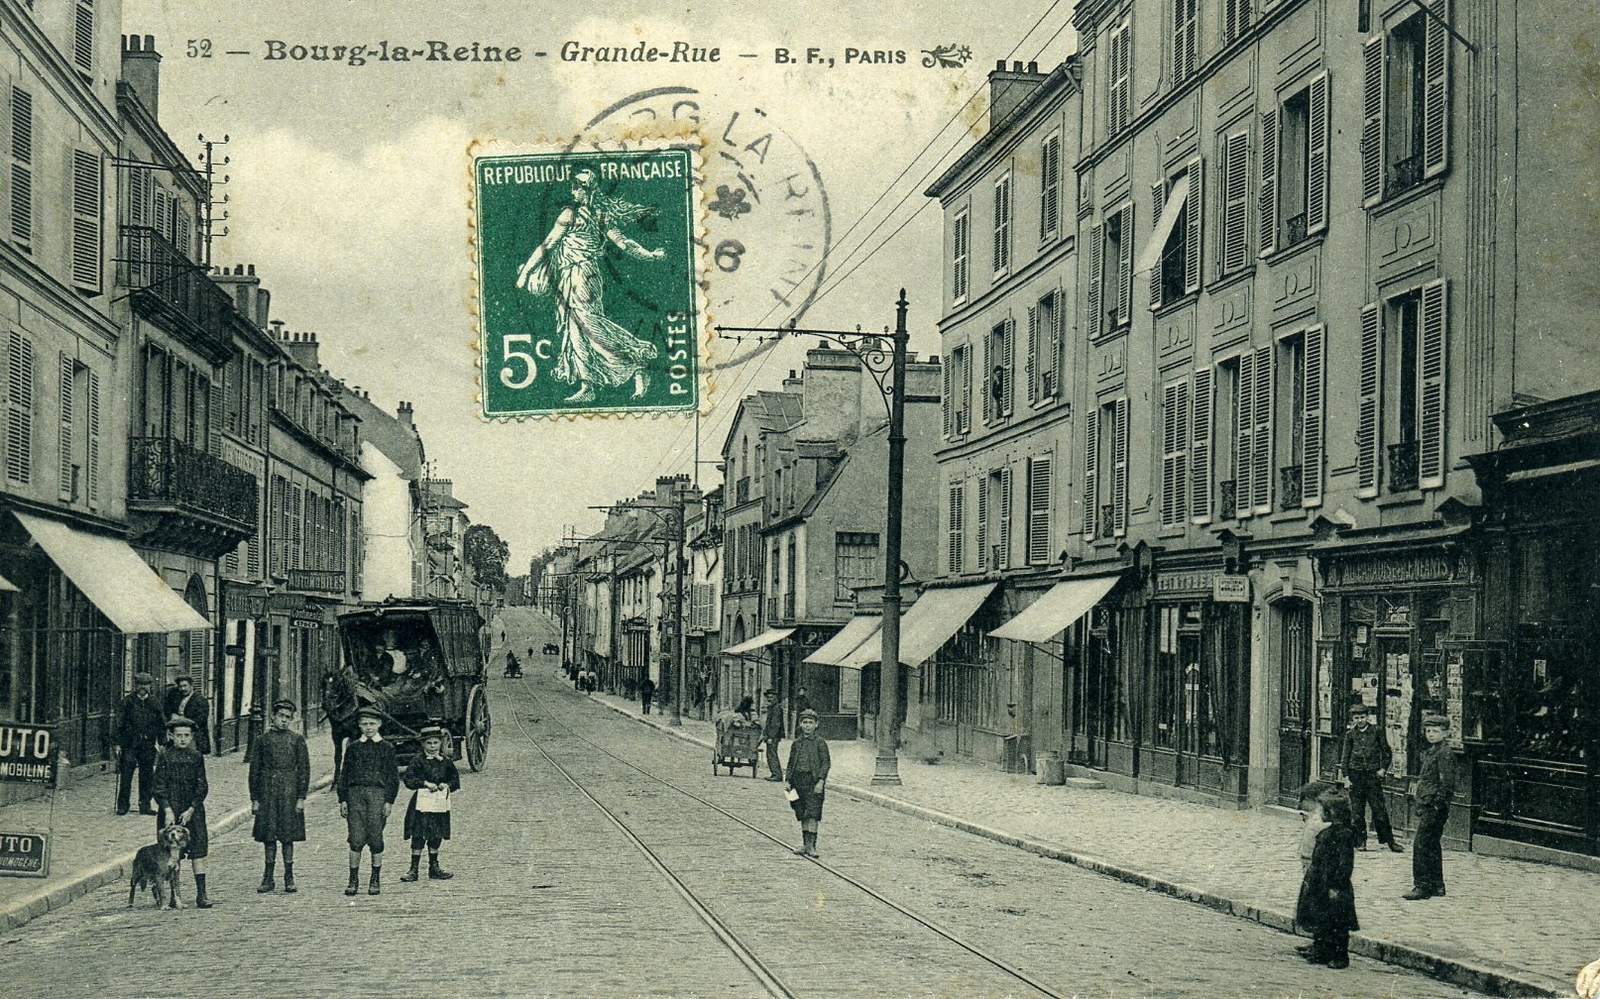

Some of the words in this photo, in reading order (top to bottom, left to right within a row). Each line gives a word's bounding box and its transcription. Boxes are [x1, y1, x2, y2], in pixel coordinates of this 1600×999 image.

[600, 160, 683, 183] FRANÇAISE
[667, 310, 688, 396] POSTES
[288, 571, 345, 590] AUTOMOBILES
[296, 620, 316, 629] STOCK
[0, 762, 52, 778] MOBILINE
